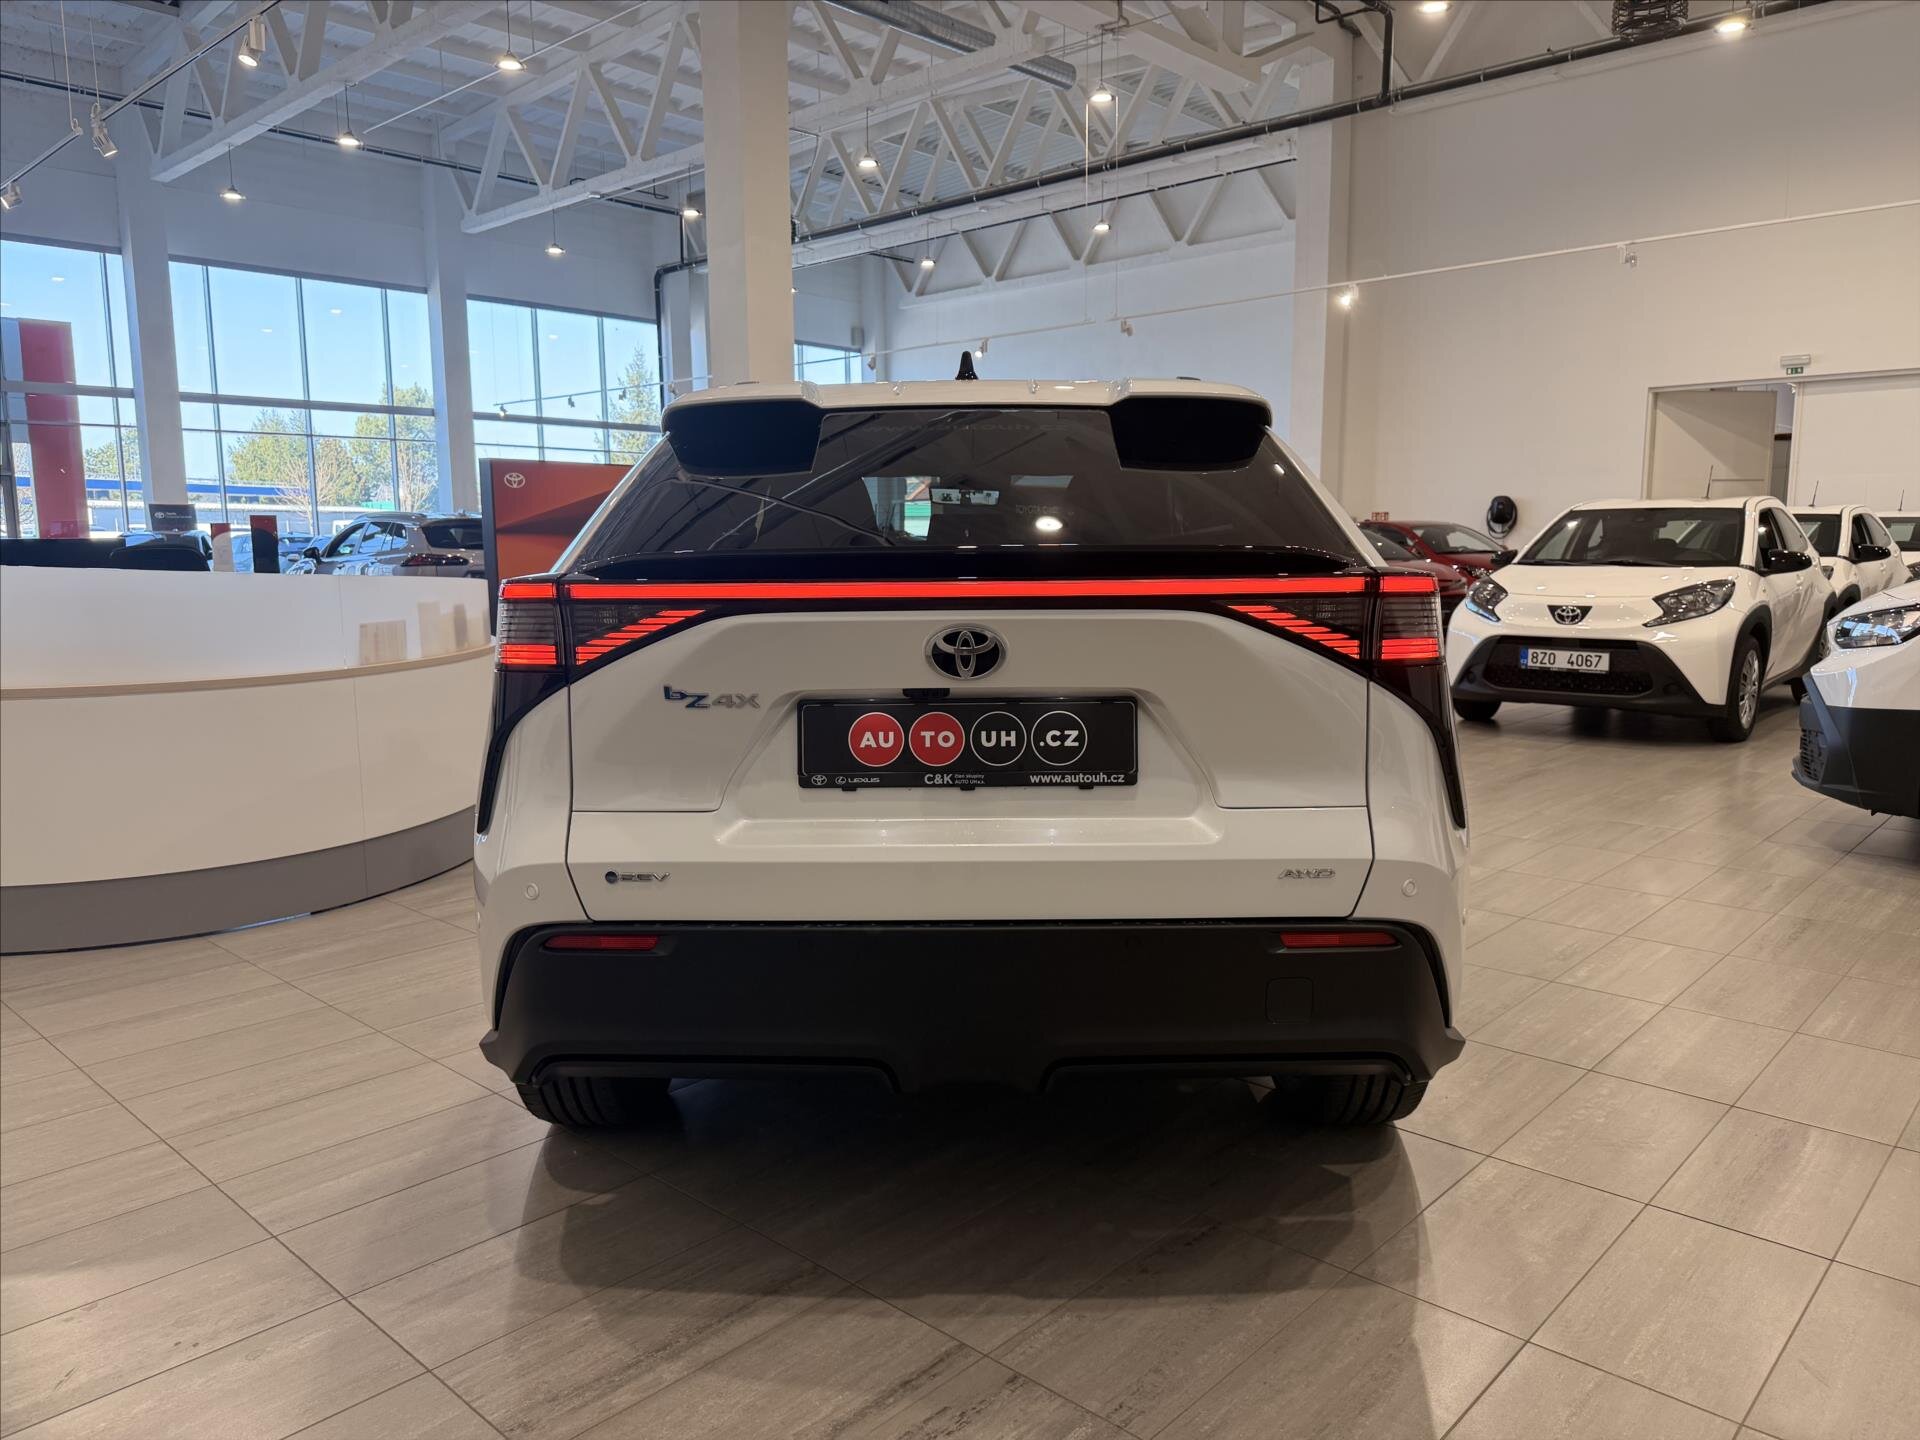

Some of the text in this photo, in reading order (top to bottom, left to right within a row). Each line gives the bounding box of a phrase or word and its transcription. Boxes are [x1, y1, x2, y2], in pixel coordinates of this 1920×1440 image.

[1566, 653, 1602, 668] 4067
[859, 729, 1080, 748] AU TO UH .CZ
[924, 773, 953, 785] C&K
[1029, 772, 1125, 784] www.autouh.cz
